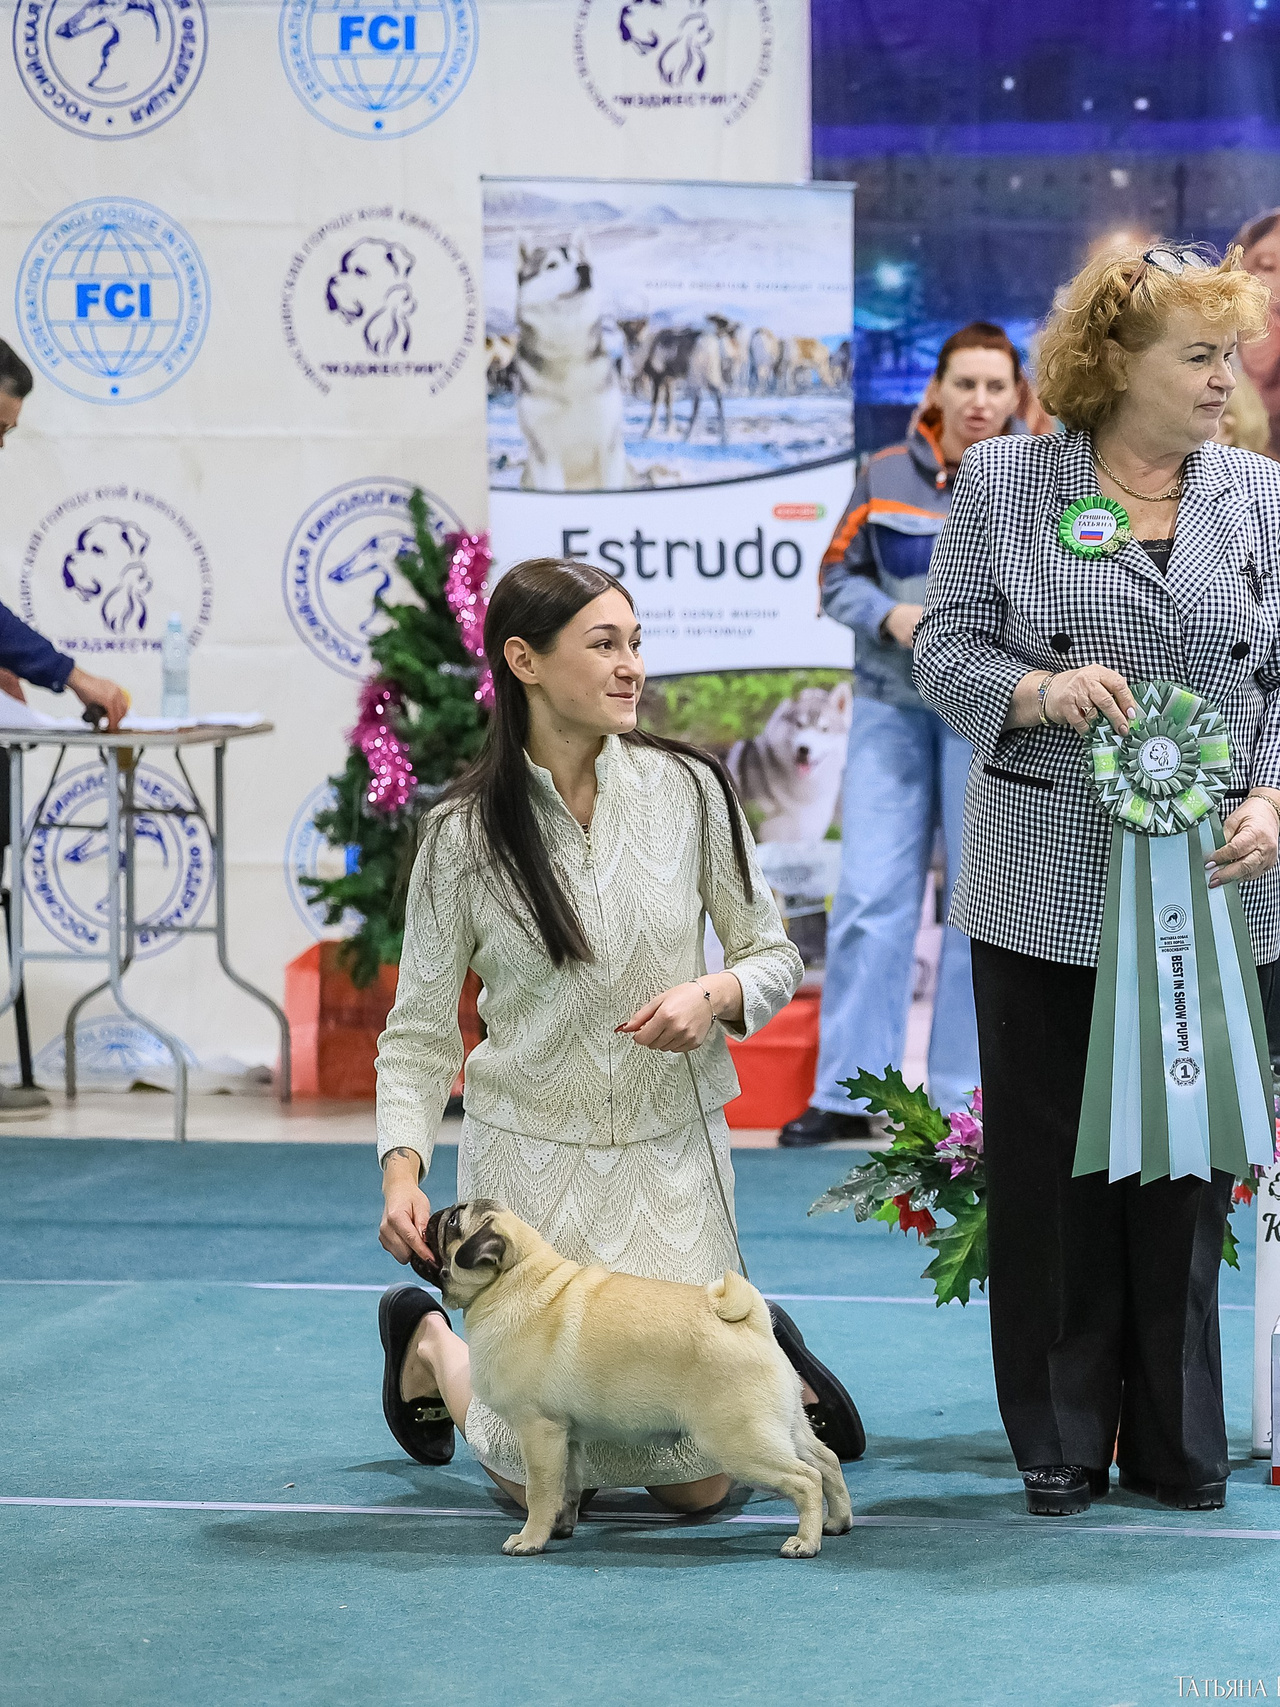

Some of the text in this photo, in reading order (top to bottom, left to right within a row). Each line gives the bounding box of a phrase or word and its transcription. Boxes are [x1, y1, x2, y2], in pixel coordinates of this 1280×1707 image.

[340, 15, 416, 50] FCI
[24, 2, 92, 123] РОССИЙСКАЯ
[76, 283, 151, 318] FCI
[562, 526, 803, 580] Estrudo
[1171, 955, 1190, 1053] BEST IN SHOW PUPPY
[1180, 1064, 1191, 1079] 1
